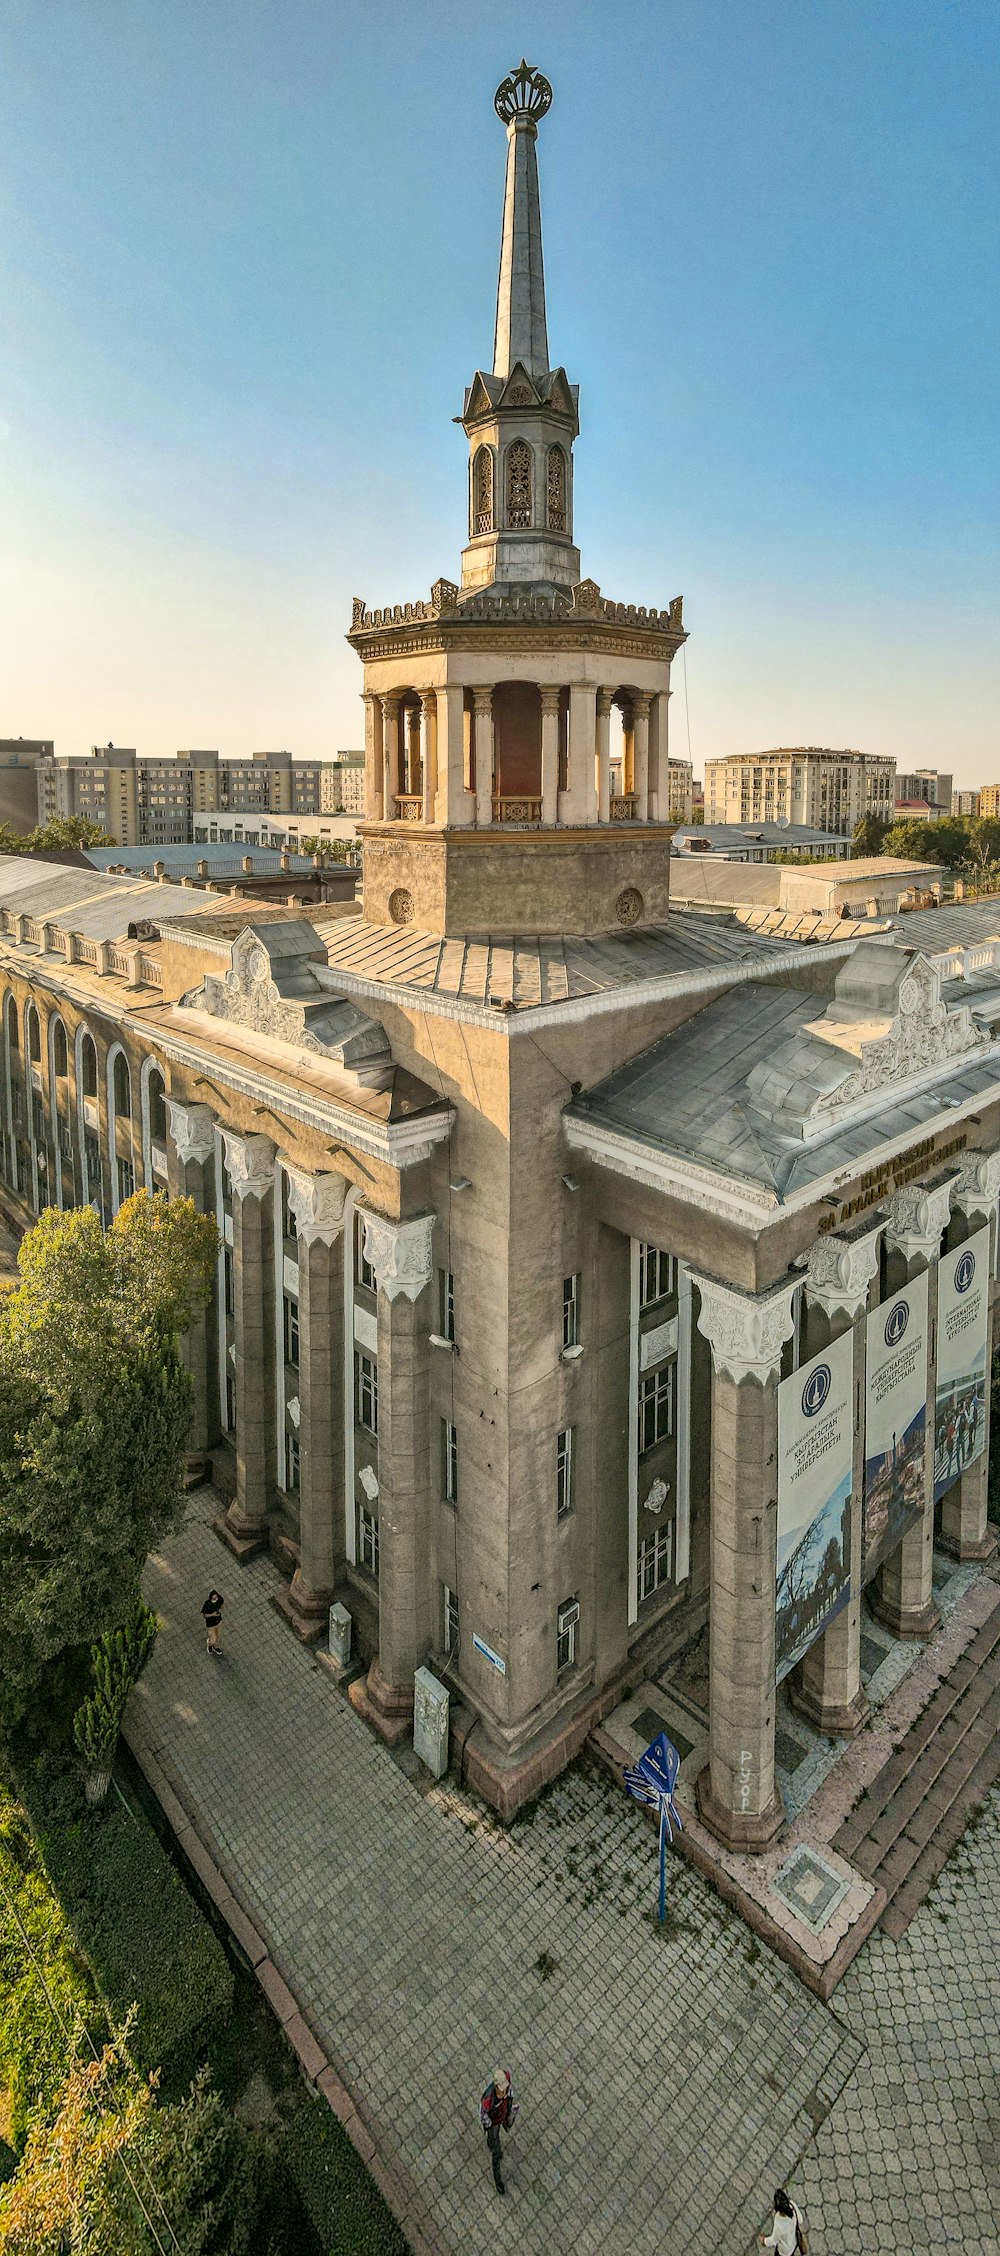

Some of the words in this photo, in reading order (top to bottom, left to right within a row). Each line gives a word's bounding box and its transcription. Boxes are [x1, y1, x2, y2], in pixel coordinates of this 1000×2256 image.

[818, 1212, 836, 1235] ЭЛ
[840, 1180, 889, 1223] АРАЛЫК
[871, 1341, 922, 1391] МЕЖДУНАРОДНЫЙ
[875, 1366, 916, 1404] КЫРГЫЗСТАНА
[877, 1356, 915, 1393] УНИВЕРСИТЕТ
[790, 1433, 842, 1484] УНИВЕРСИТЕТИ
[794, 1416, 838, 1461] КЫРГЫЗСТАН
[797, 1454, 808, 1468] ЭЛ
[806, 1428, 836, 1459] АРАЛЫК
